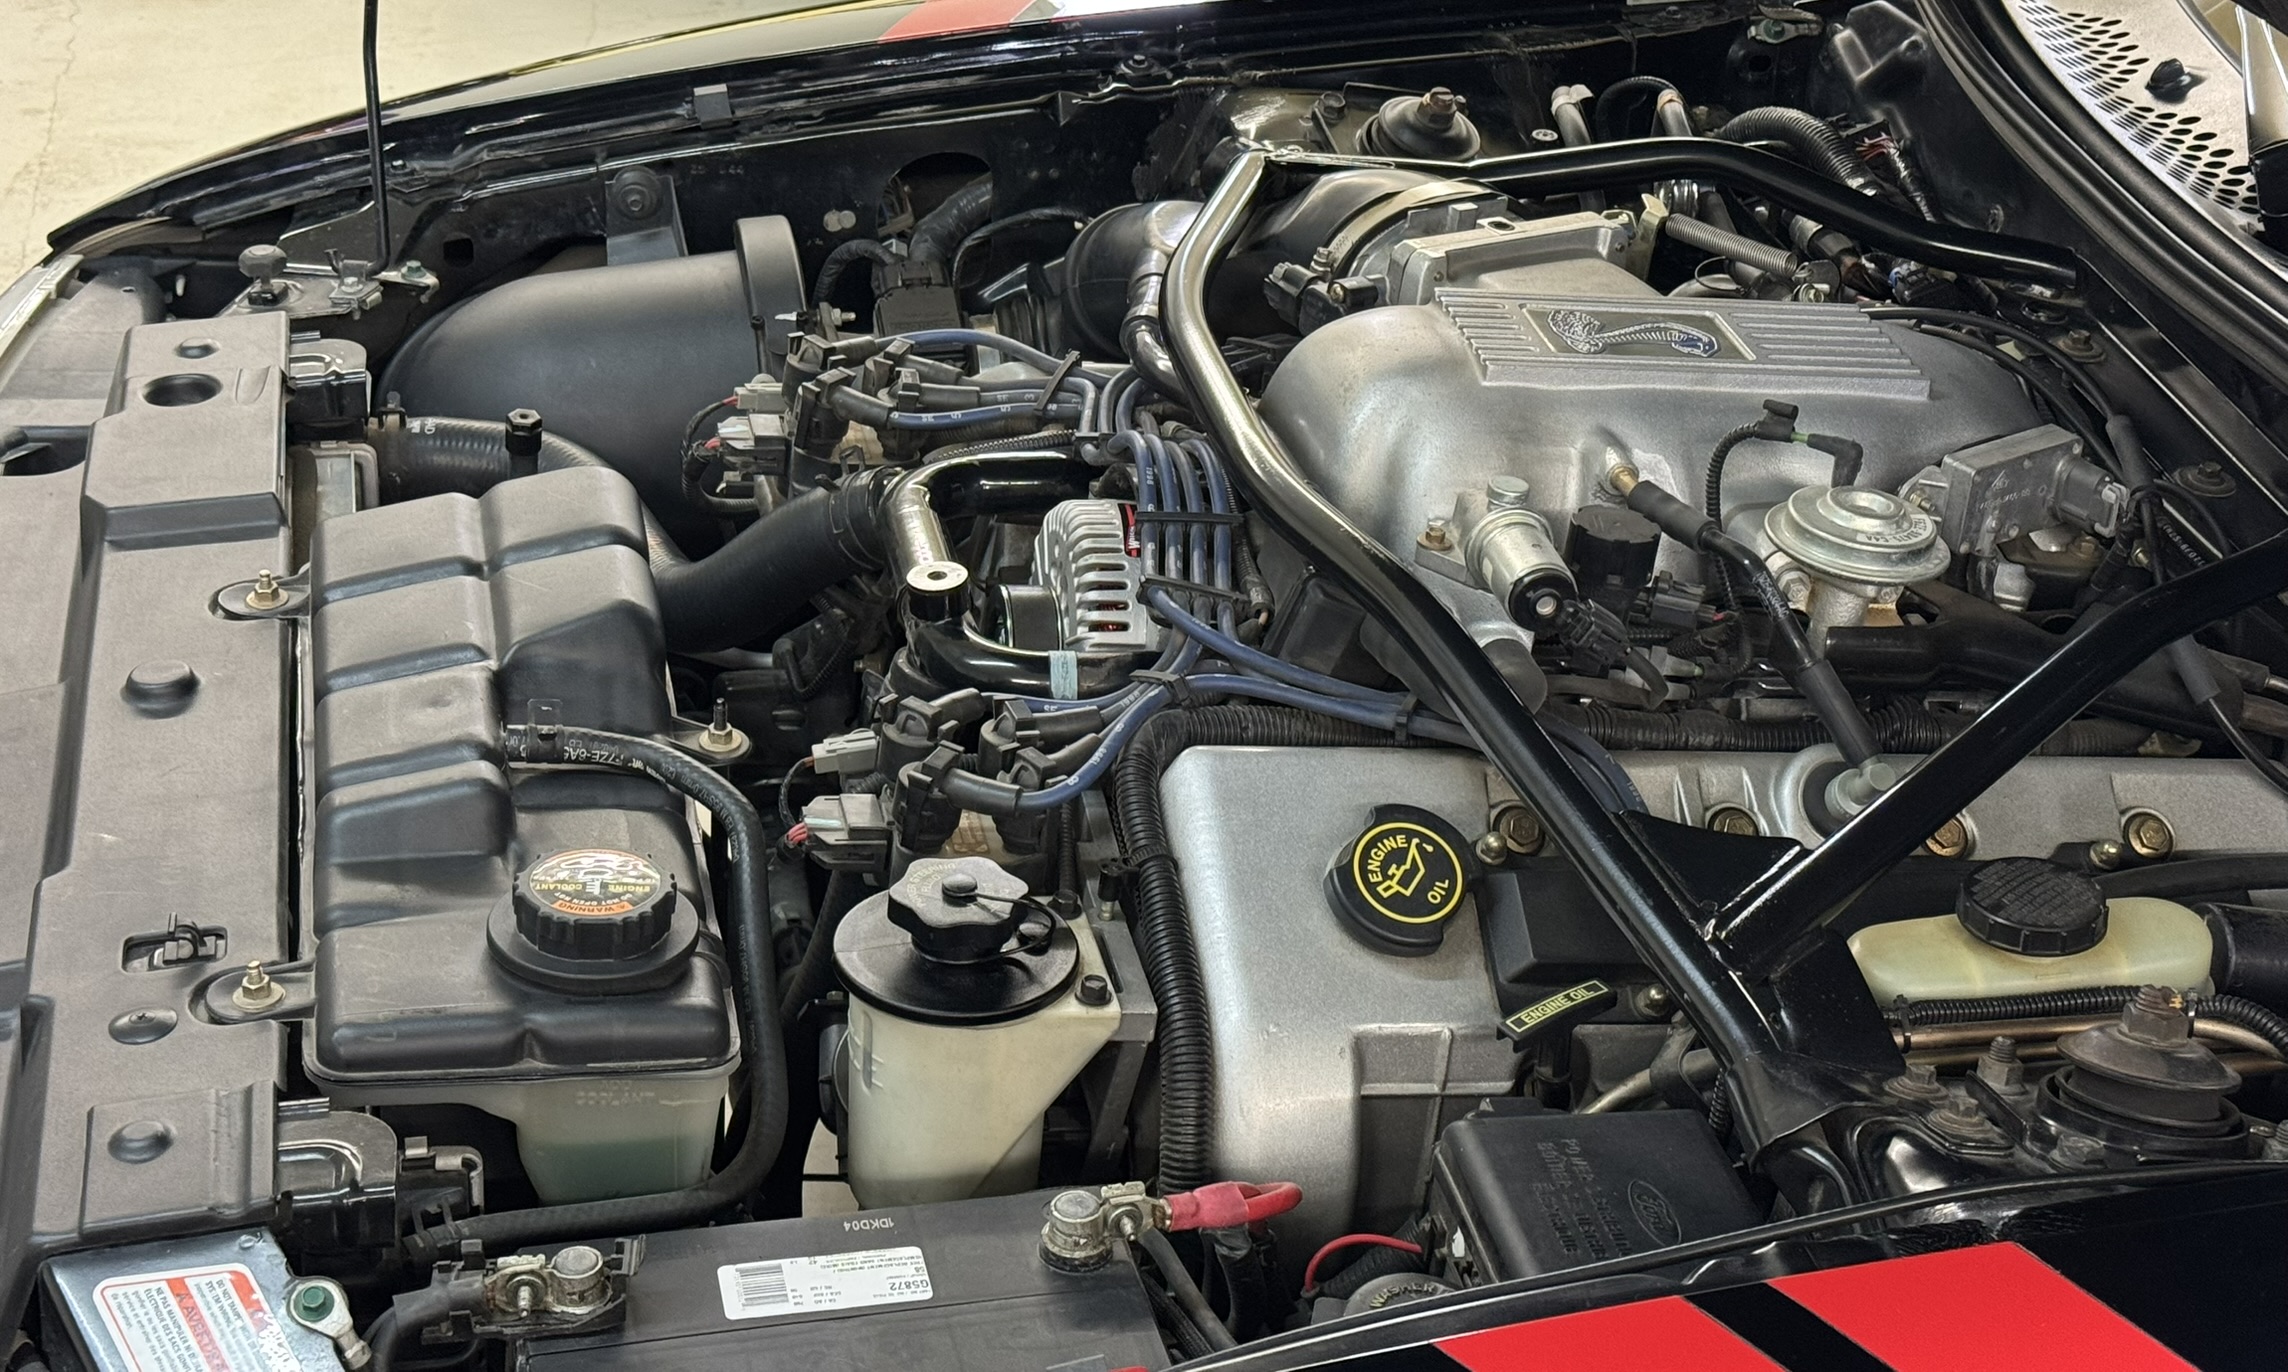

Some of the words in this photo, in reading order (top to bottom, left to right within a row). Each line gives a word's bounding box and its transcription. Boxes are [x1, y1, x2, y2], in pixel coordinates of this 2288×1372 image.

[1368, 834, 1408, 883] ENGINE
[1427, 878, 1449, 905] OIL
[535, 883, 582, 891] COOLANT
[608, 884, 650, 892] ENGINE
[560, 902, 615, 913] WARNING
[572, 898, 598, 906] OPEN
[601, 897, 620, 906] NOT
[1522, 996, 1572, 1025] ENGINE
[1569, 987, 1595, 1002] OIL
[843, 1216, 894, 1232] 1DKD04
[888, 1279, 929, 1292] G5872
[216, 1279, 225, 1288] DO
[221, 1288, 233, 1300] NOT
[228, 1300, 244, 1326] TAMPE
[1369, 1282, 1435, 1308] WASHER
[154, 1286, 164, 1296] NE
[159, 1296, 170, 1309] PAS
[166, 1308, 189, 1346] MANIPULER
[161, 1323, 172, 1336] DES
[168, 1336, 182, 1354] SACS
